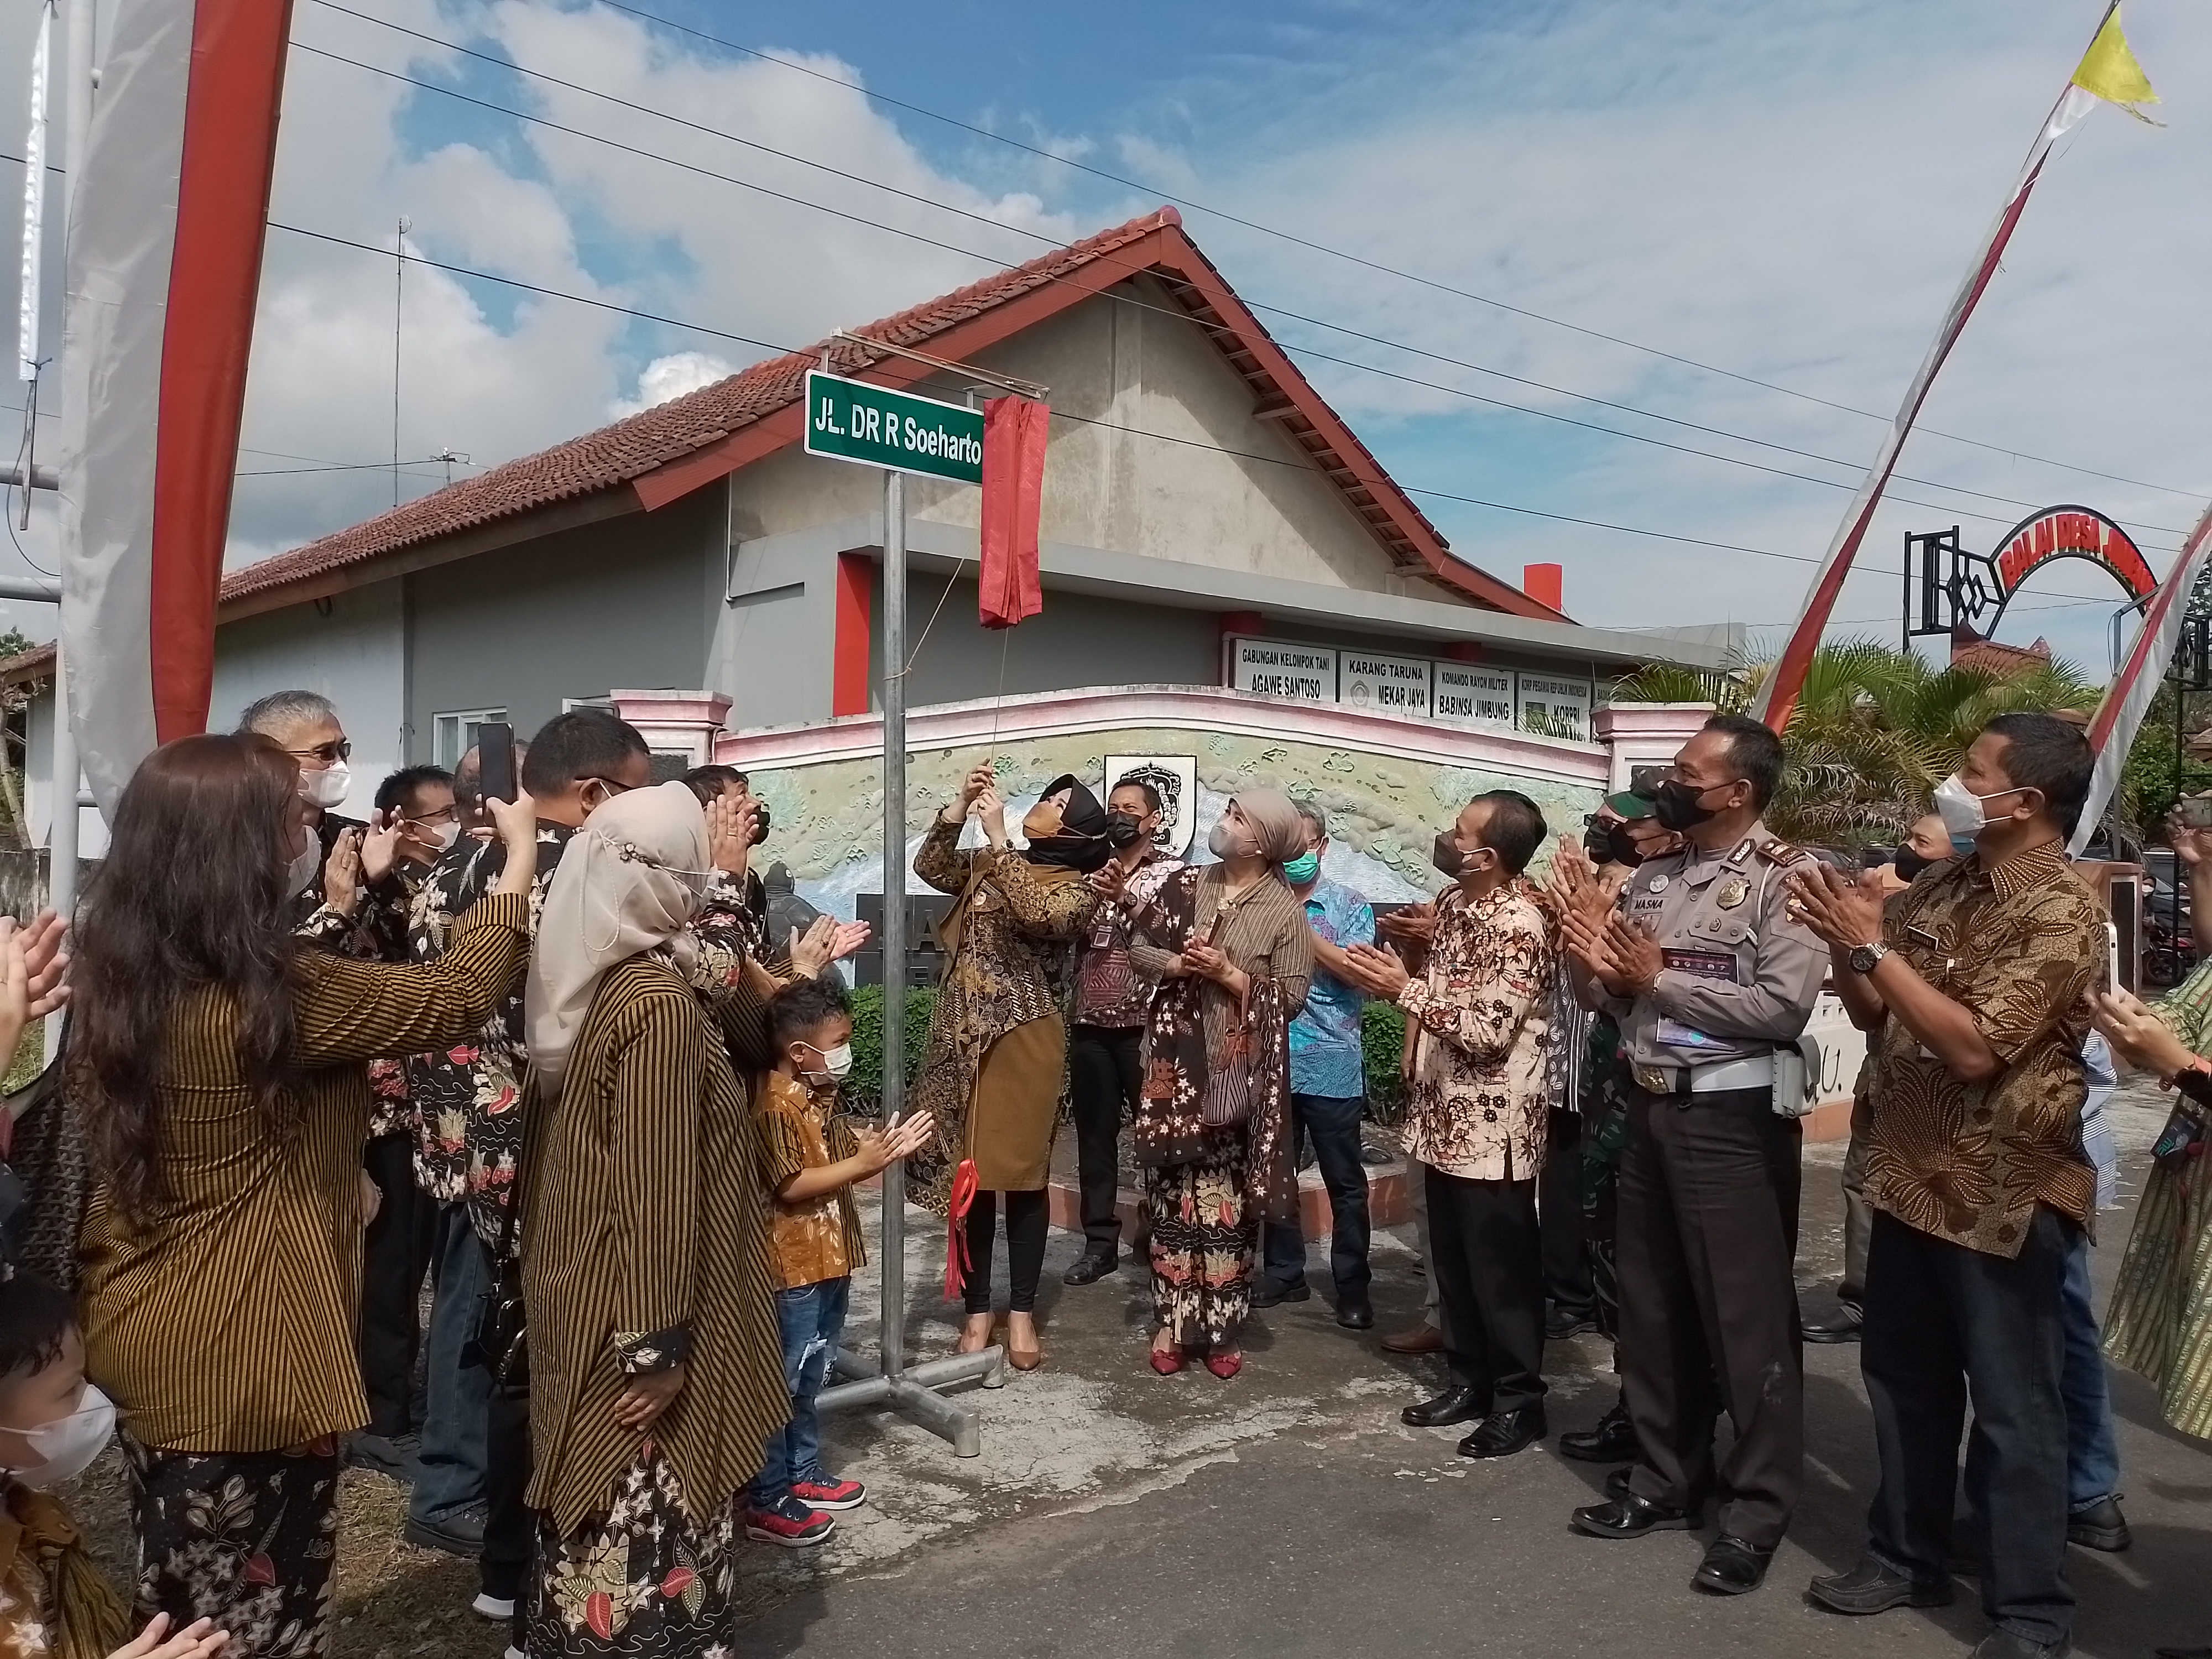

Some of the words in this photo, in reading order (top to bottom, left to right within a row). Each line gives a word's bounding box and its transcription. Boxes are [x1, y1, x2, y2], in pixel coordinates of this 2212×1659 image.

[815, 397, 845, 435] JL.
[852, 404, 880, 443] DR
[885, 412, 899, 448] R
[904, 417, 982, 465] Soeharto
[1999, 517, 2055, 592] BALAI
[2056, 514, 2100, 553] DESA
[1243, 649, 1278, 665] GABUNGAN
[1280, 653, 1314, 669] KELOMPOK
[1316, 656, 1329, 671] TANI
[1349, 660, 1386, 676] KARANG
[1389, 664, 1423, 680] TARUNA
[1251, 674, 1282, 695] AGAWE
[1284, 676, 1321, 699] SANTOSO
[1442, 671, 1468, 686] KOMANDO
[1470, 675, 1487, 688] RAYON
[1488, 677, 1508, 691] MILITER
[1378, 685, 1405, 706] MEKAR
[1407, 688, 1425, 708] JAYA
[1439, 695, 1473, 717] BABINSA
[1475, 700, 1509, 721] JIMBUNG
[1554, 705, 1579, 724] KORPRI
